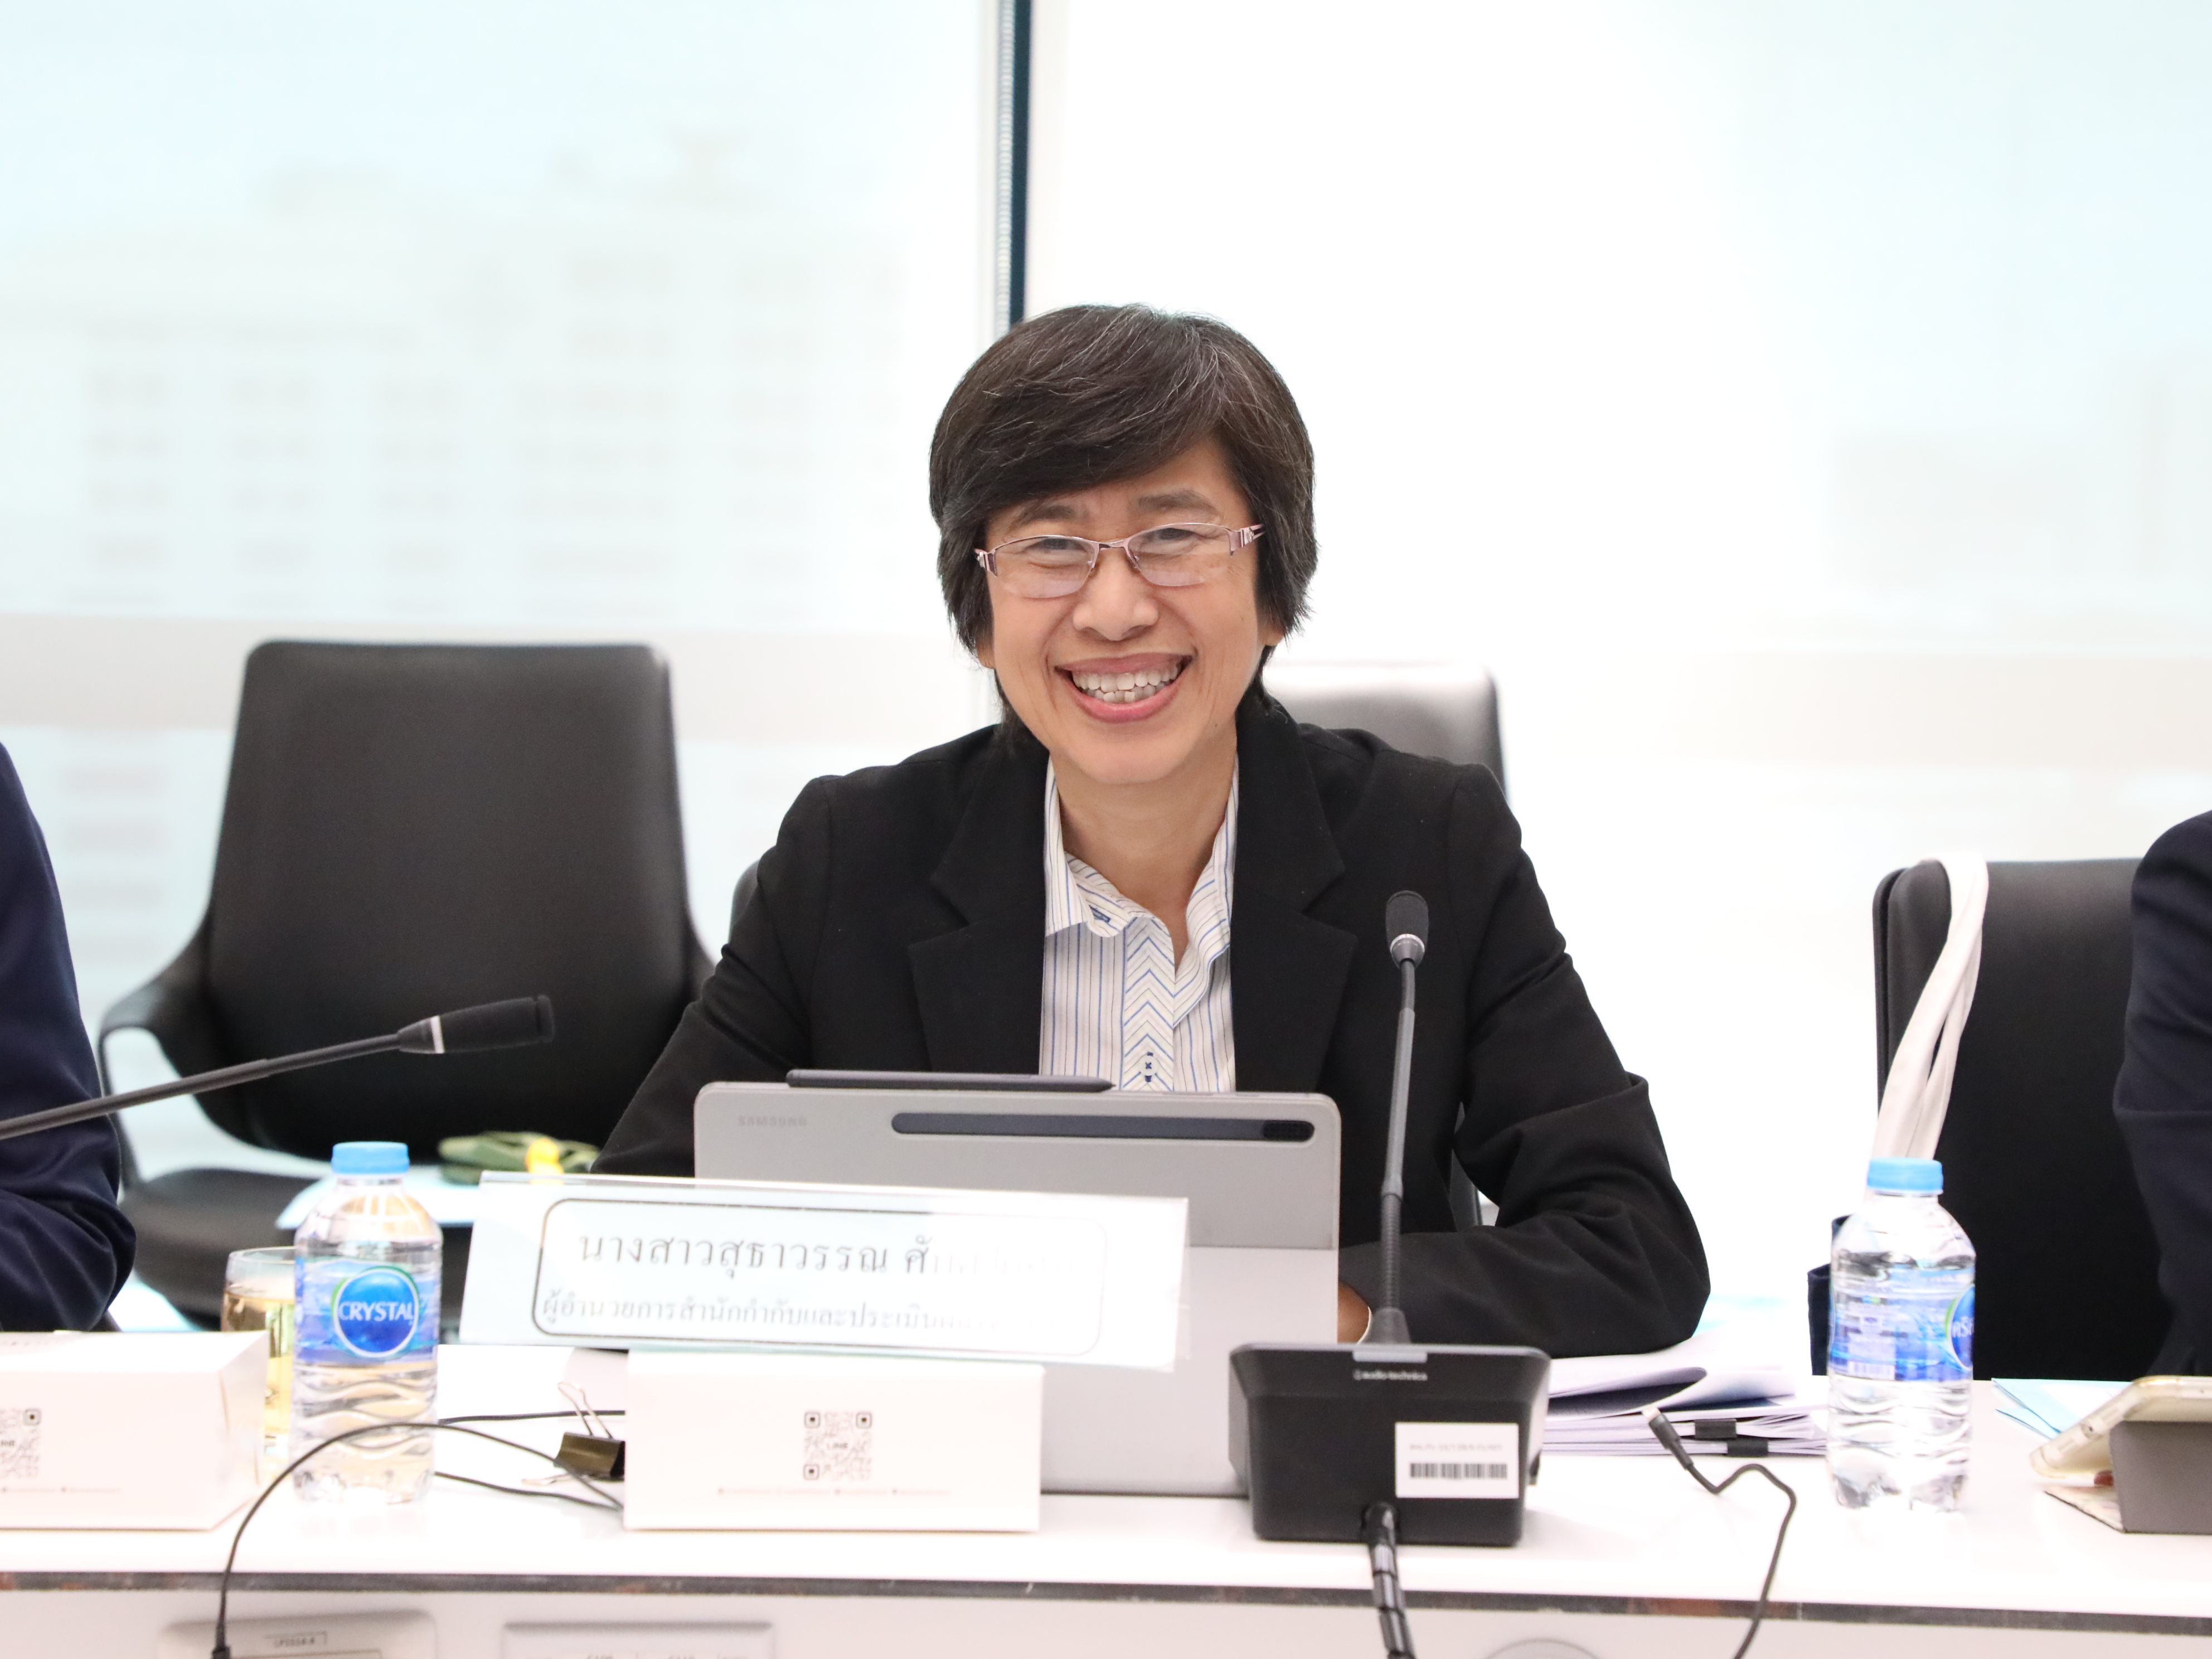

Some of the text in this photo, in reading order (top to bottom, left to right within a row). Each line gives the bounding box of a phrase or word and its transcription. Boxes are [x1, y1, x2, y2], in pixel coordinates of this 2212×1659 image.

[739, 1116, 807, 1126] SAMSUNG
[579, 1235, 887, 1280] นางสาวสุธาวรรณ
[338, 1301, 414, 1321] CRYSTAL
